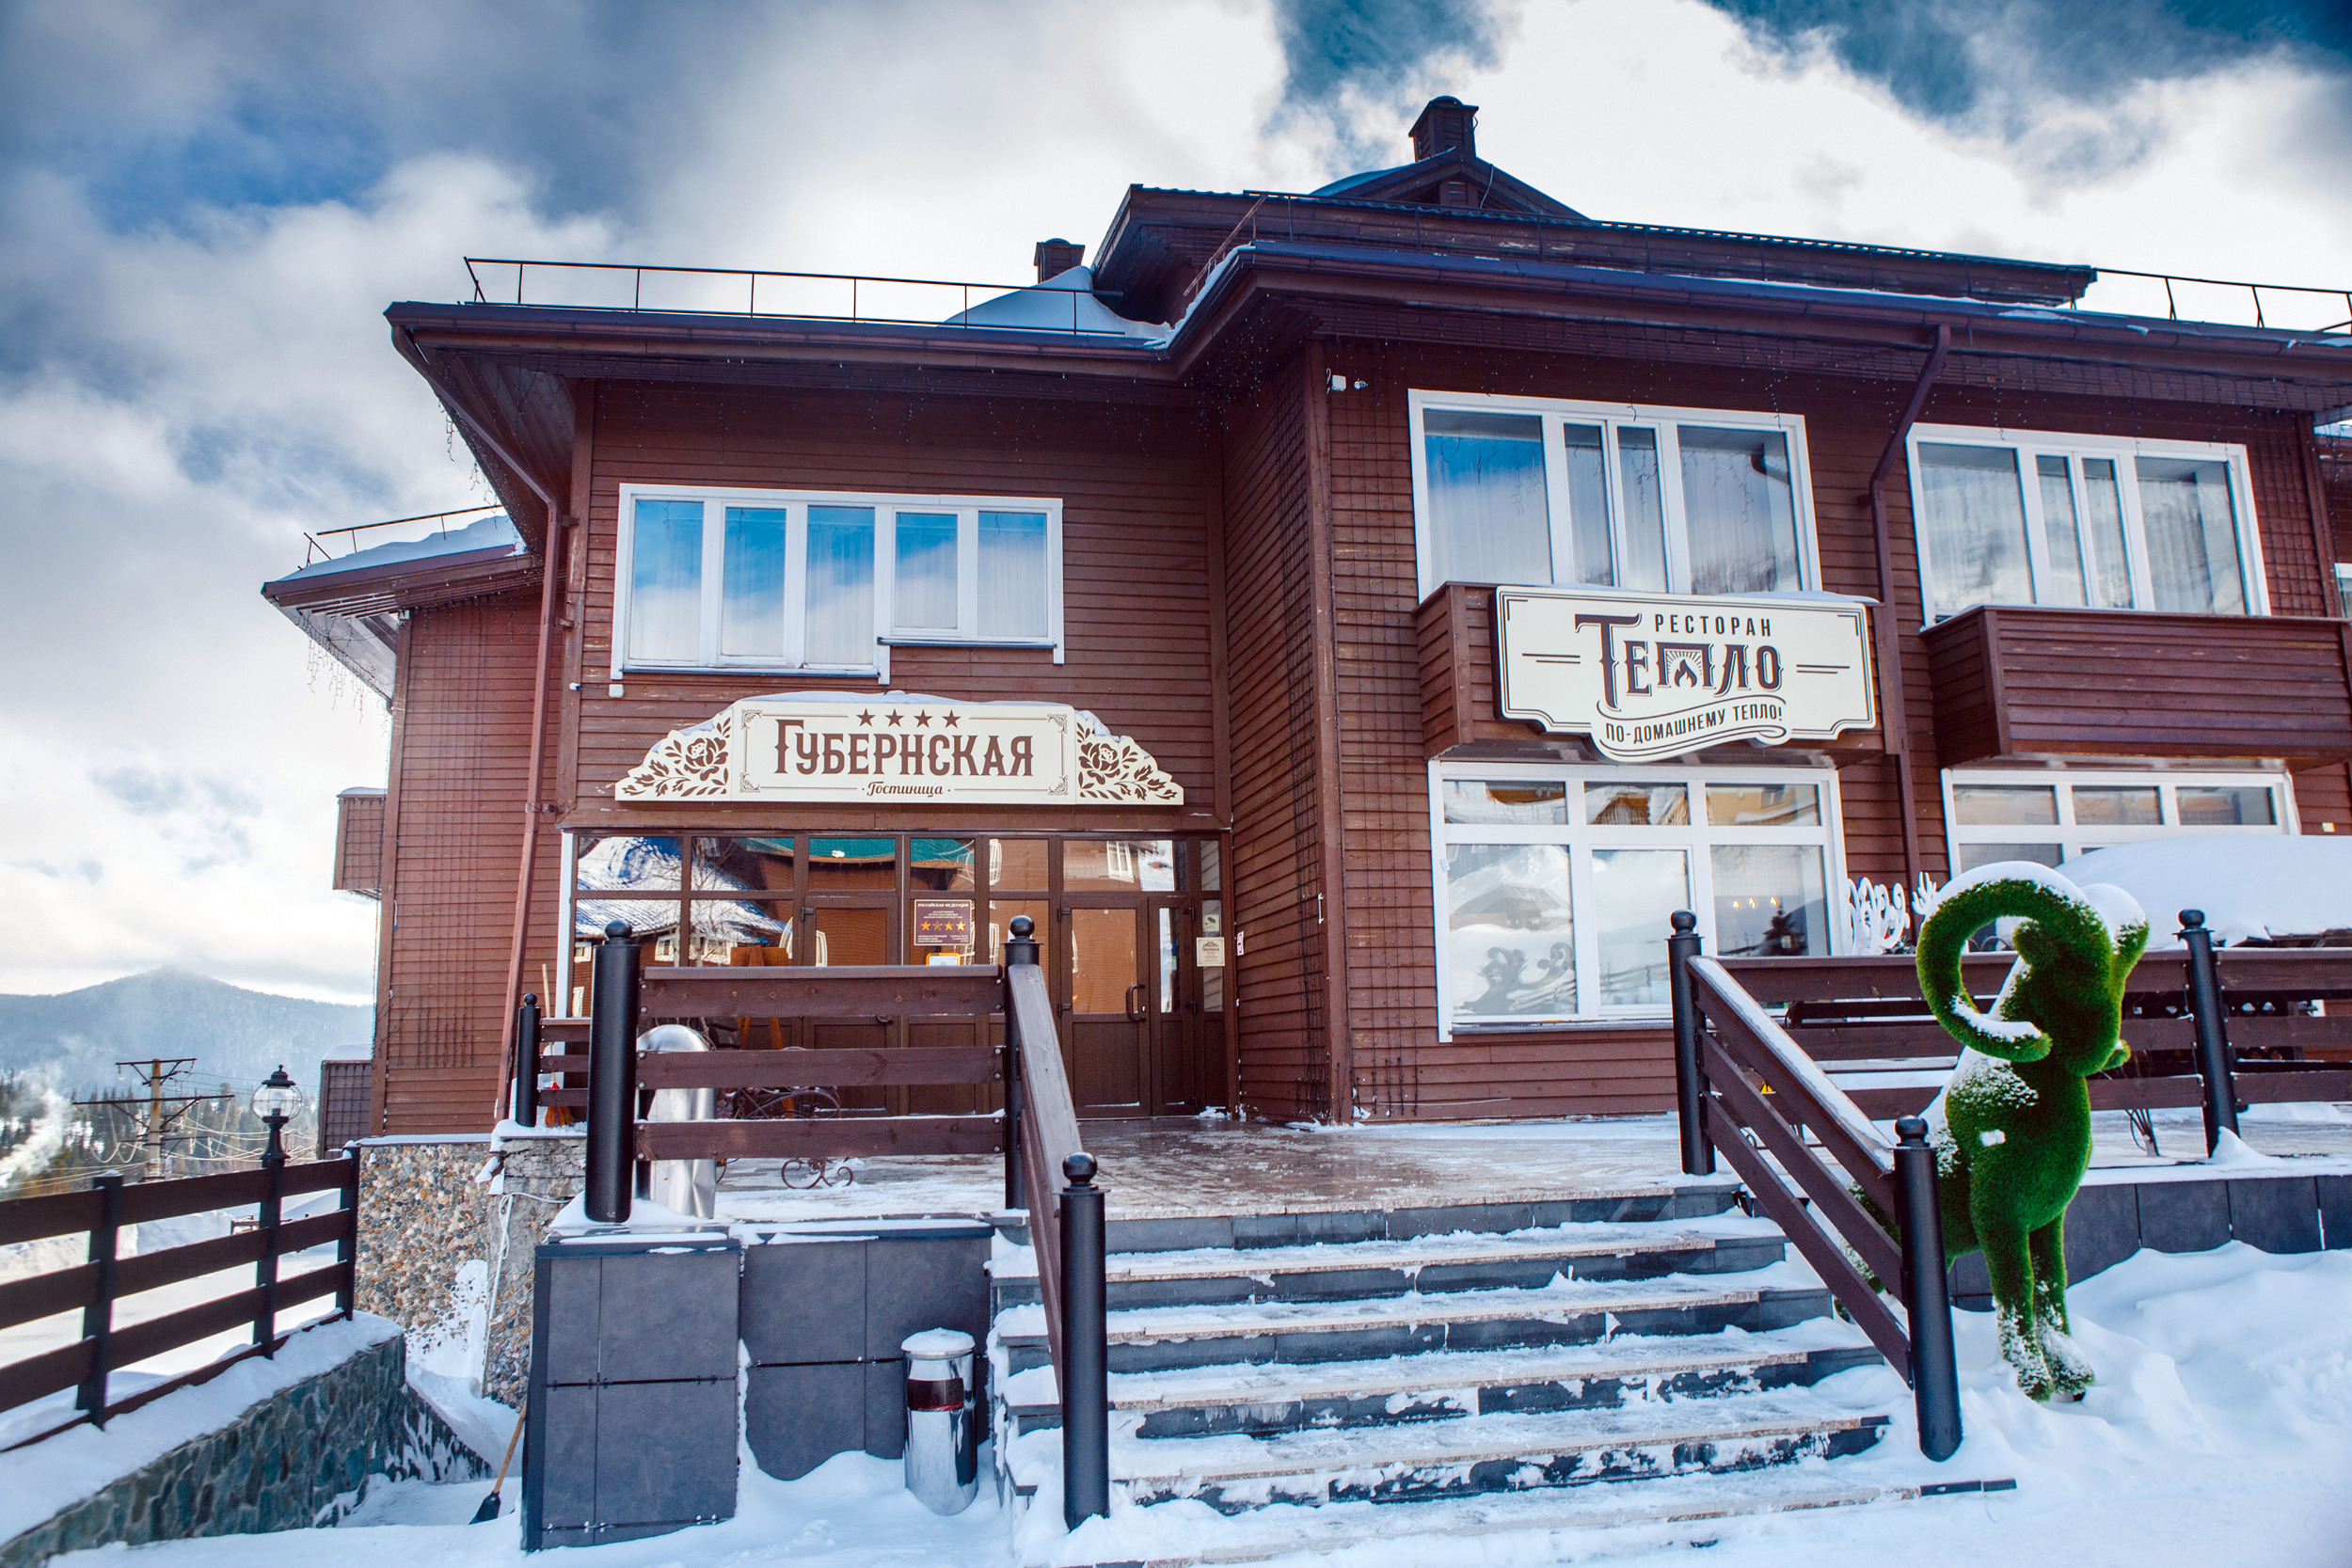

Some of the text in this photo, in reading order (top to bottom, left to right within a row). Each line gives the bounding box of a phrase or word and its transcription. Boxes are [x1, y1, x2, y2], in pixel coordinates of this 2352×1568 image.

[1655, 613, 1771, 637] РЕСТОРАН
[1575, 613, 1784, 712] ТЕПЛО
[1605, 704, 1784, 744] ПО-ДОМАШНЕМУ ТЕПЛО!
[773, 719, 1034, 777] ГУБЕРНСКАЯ
[866, 781, 944, 798] Гостиница
